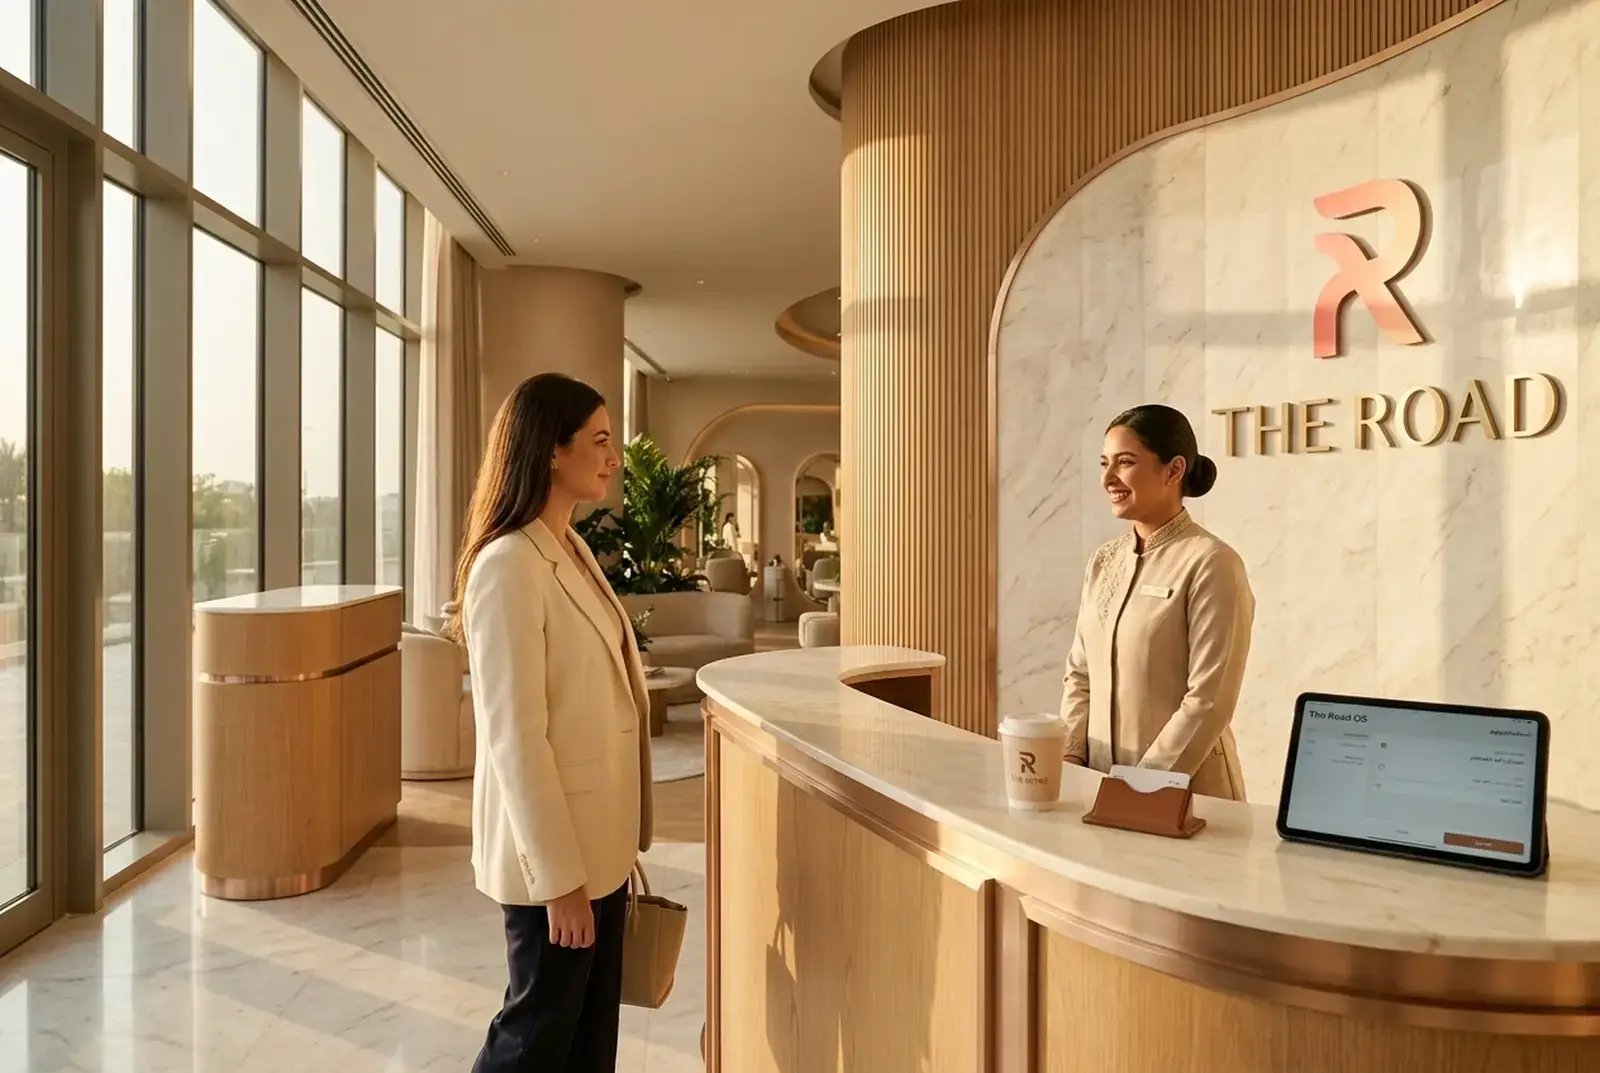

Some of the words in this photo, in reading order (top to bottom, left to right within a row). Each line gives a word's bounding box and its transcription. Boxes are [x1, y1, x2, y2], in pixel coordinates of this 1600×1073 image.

[1313, 178, 1433, 358] R
[1211, 398, 1339, 457] THE
[1354, 372, 1566, 449] ROAD
[1328, 711, 1352, 721] Road
[1353, 714, 1368, 723] OS
